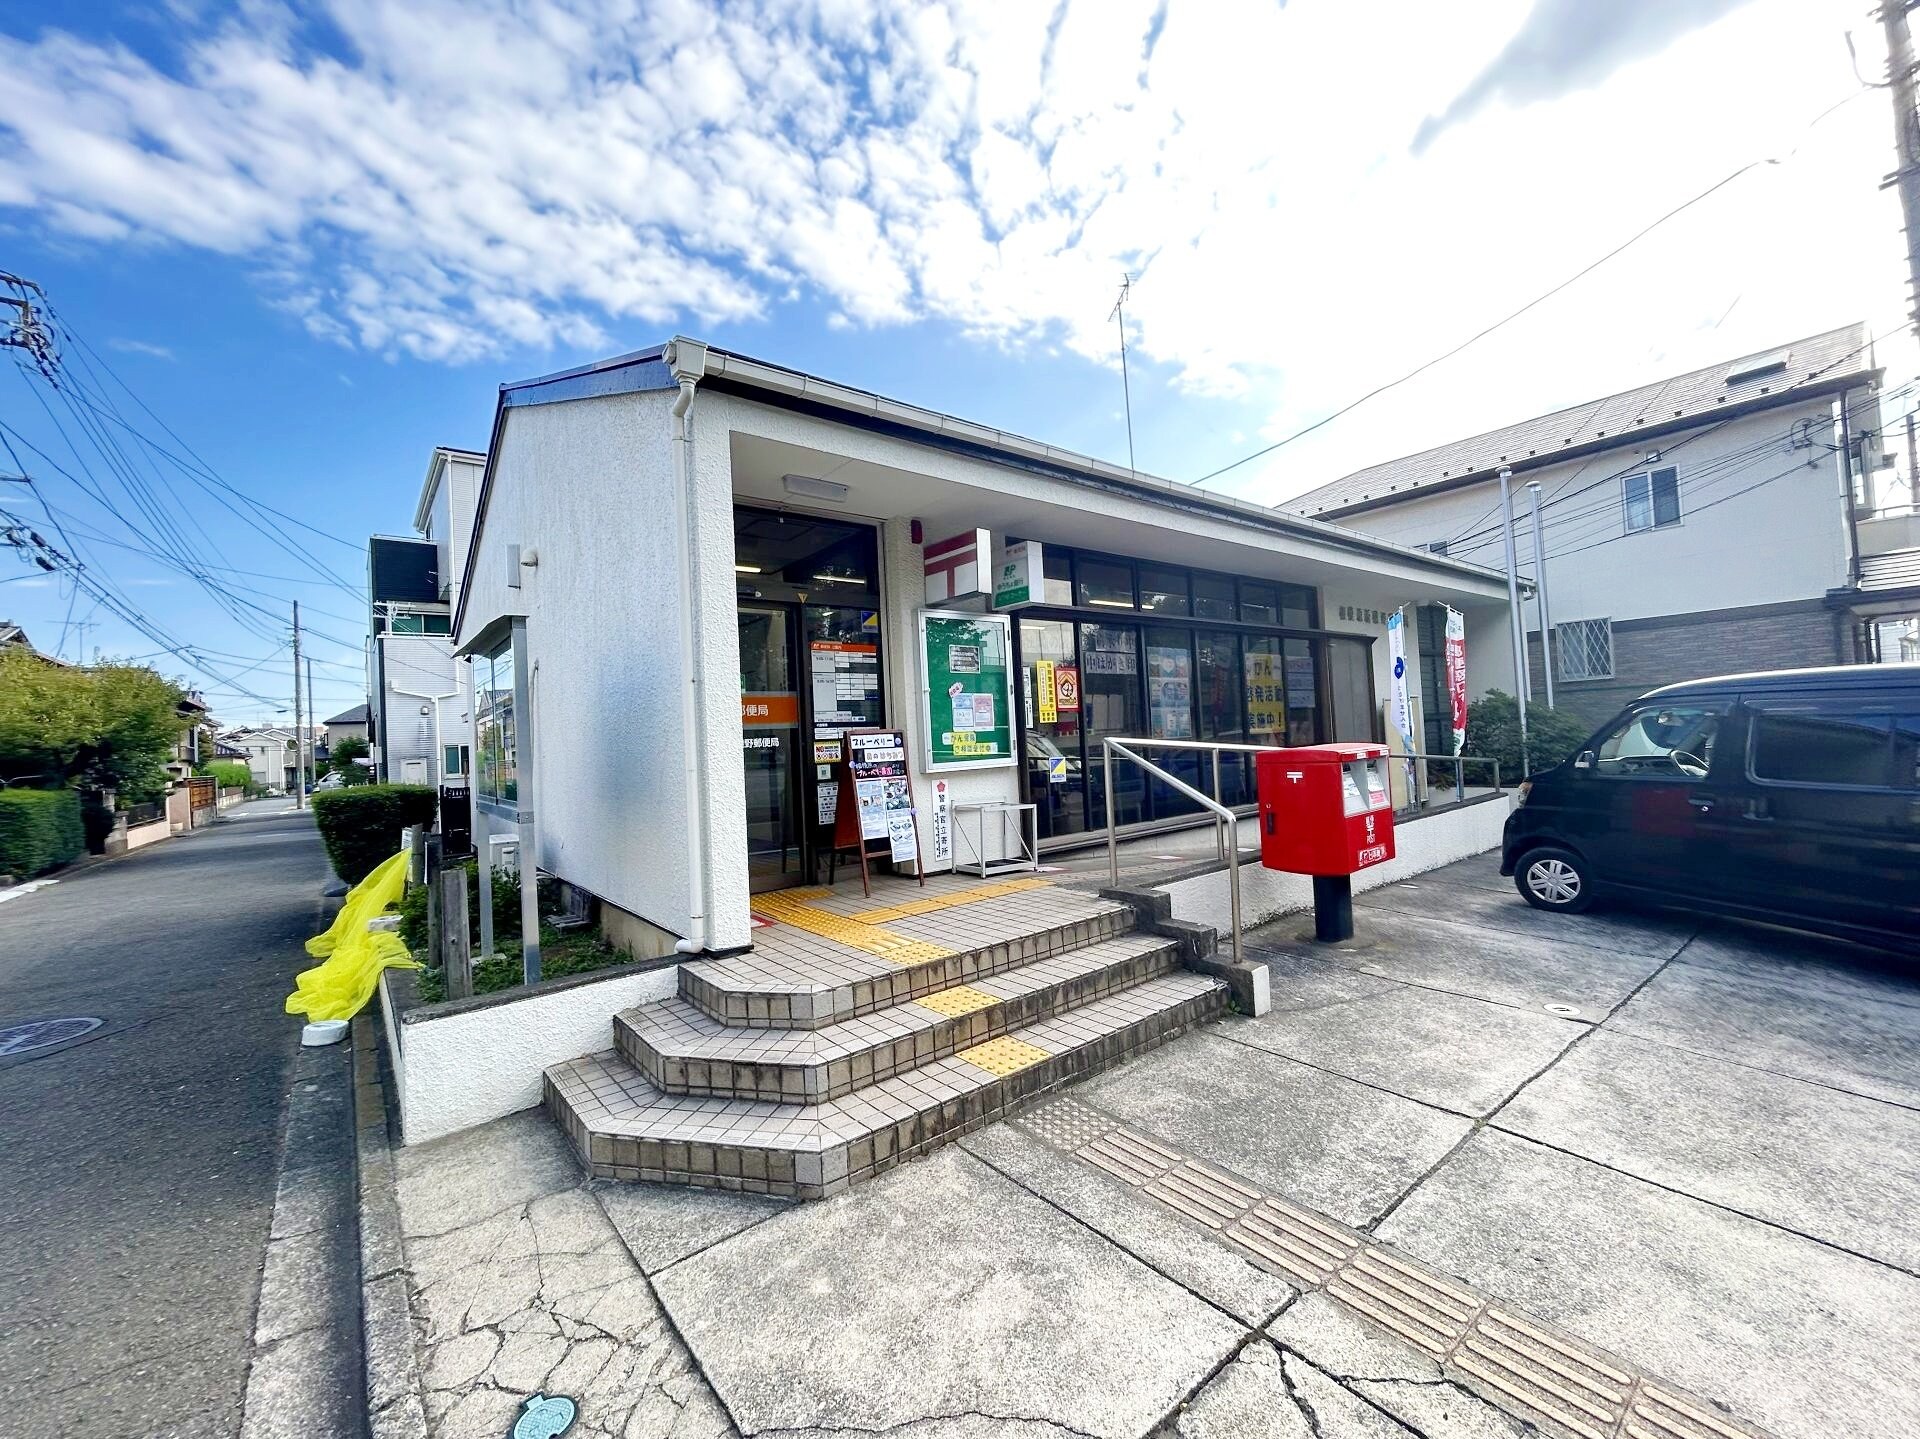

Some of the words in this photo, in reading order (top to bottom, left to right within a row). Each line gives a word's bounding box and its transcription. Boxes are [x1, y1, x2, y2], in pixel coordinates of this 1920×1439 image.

[852, 738, 893, 746] ブルーベリー
